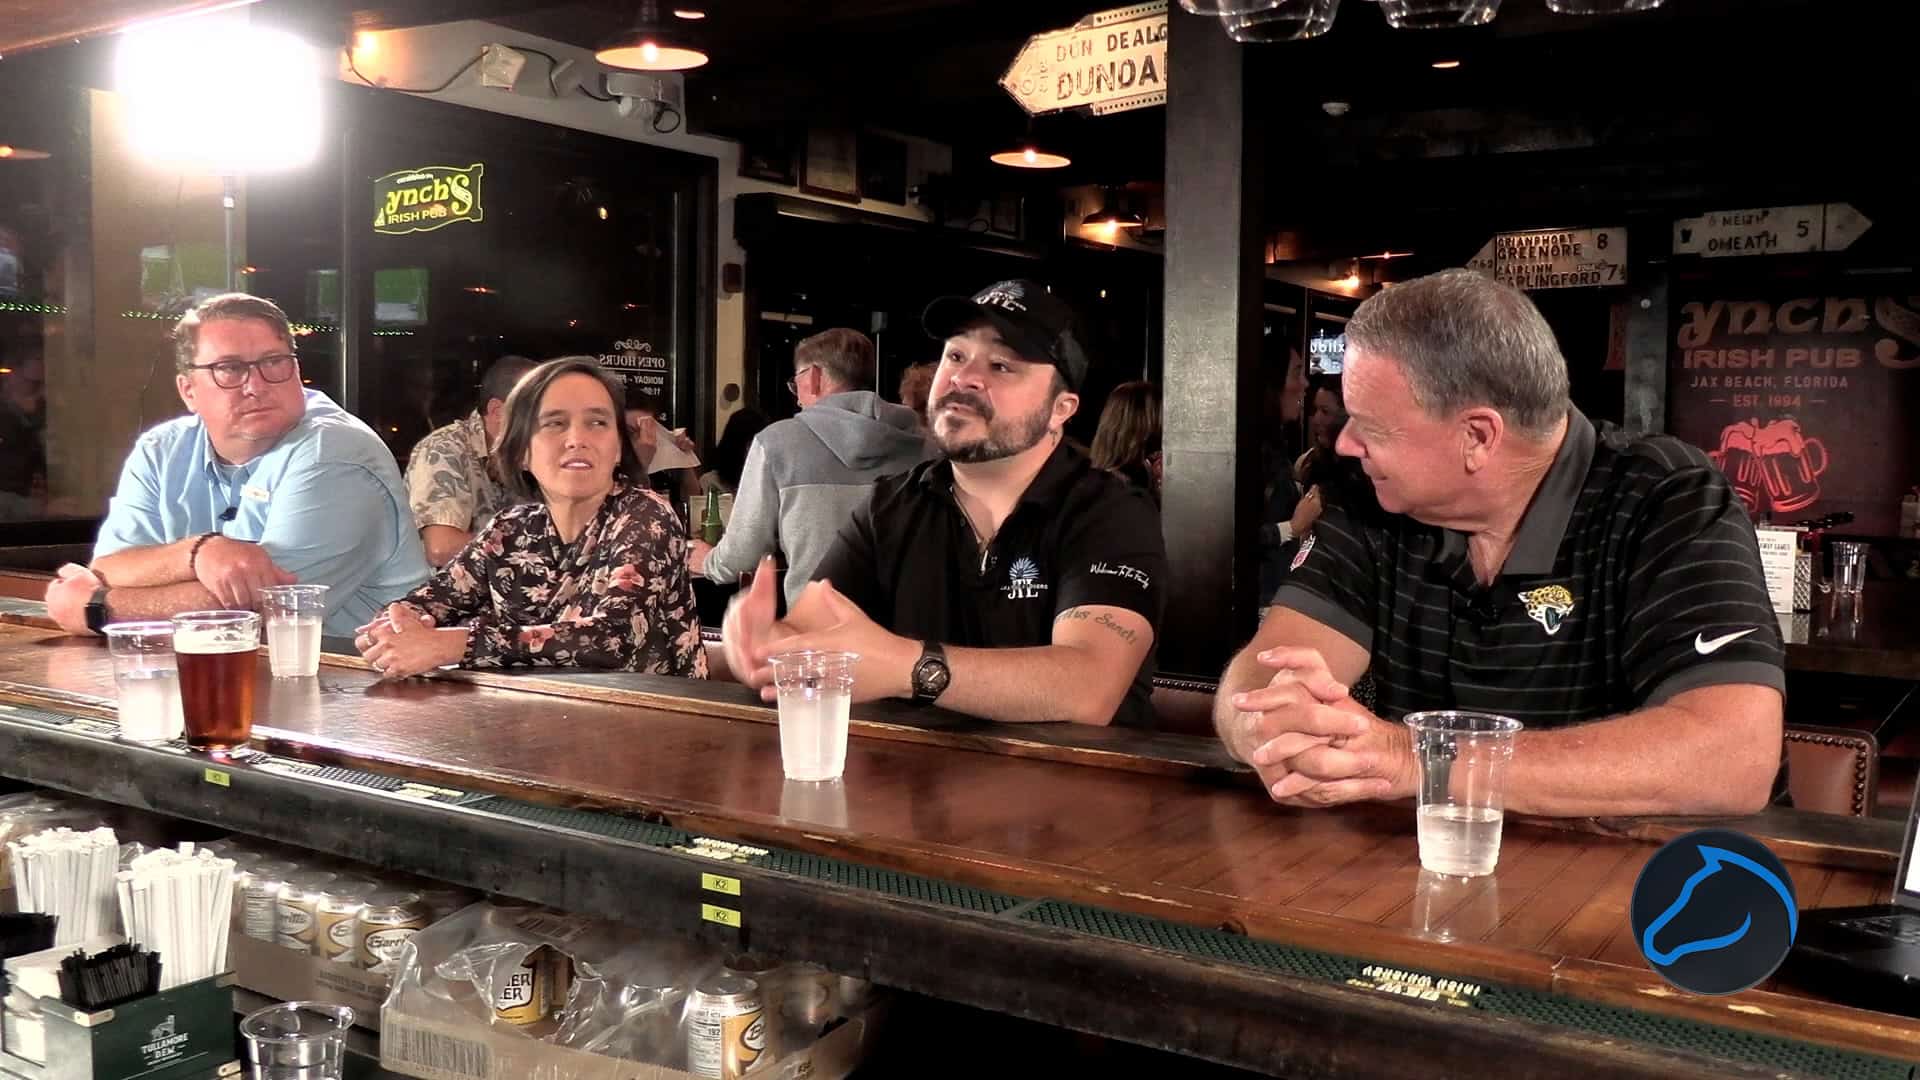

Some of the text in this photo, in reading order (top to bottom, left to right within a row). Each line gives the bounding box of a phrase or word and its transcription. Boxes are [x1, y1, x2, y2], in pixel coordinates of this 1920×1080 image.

[388, 207, 448, 225] IRISH PUB
[1596, 232, 1609, 250] 8
[1708, 219, 1809, 252] OMEATH 5
[1498, 243, 1583, 261] GREENORE
[1683, 347, 1864, 369] IRISH PUB
[1690, 375, 1718, 389] JAX
[1784, 375, 1849, 389] FLORIDA
[141, 1032, 189, 1055] TULLAMORE
